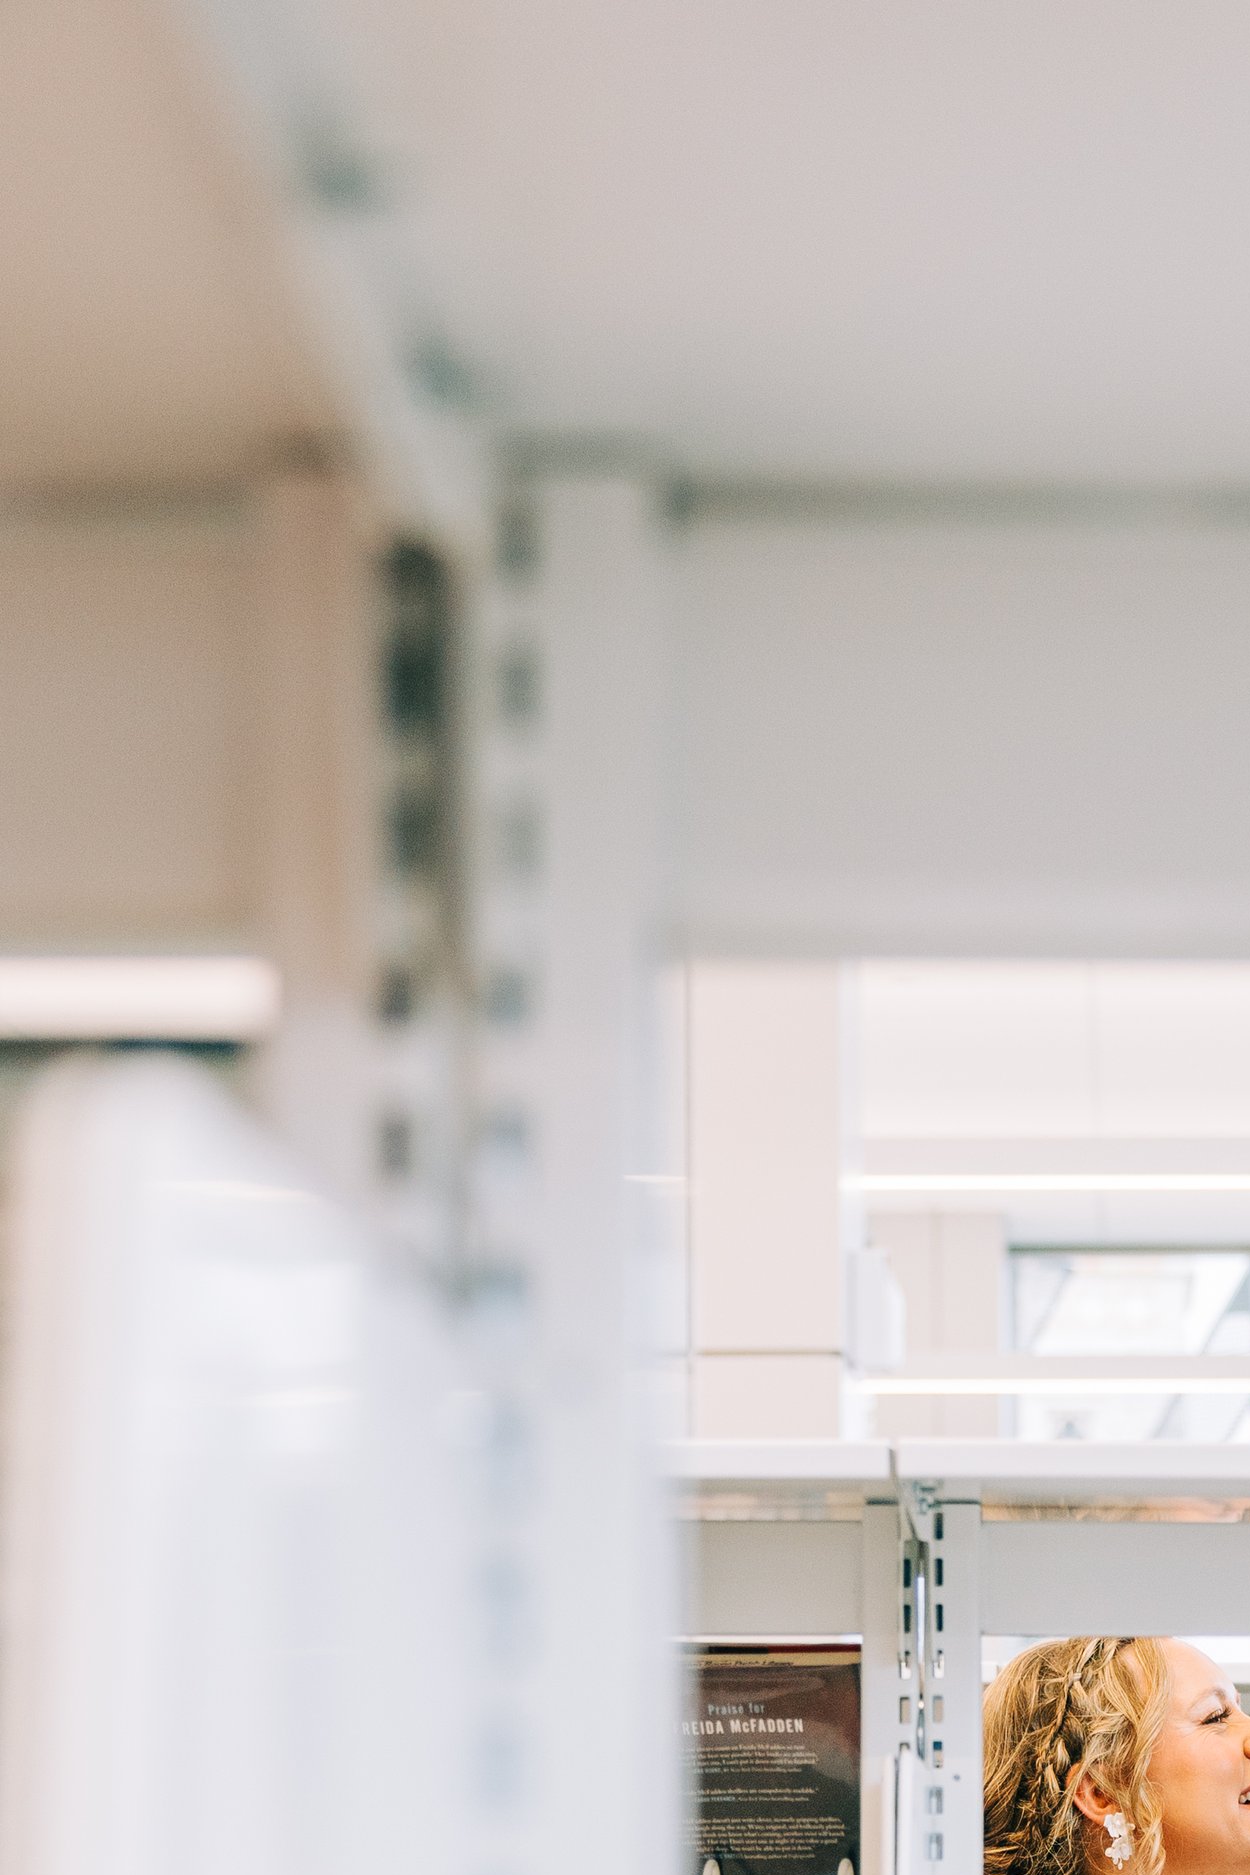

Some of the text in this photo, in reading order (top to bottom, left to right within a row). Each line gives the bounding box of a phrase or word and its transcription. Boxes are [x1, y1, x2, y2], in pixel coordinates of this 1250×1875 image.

[707, 1703, 765, 1716] Praise for
[729, 1718, 804, 1734] McFADDEN
